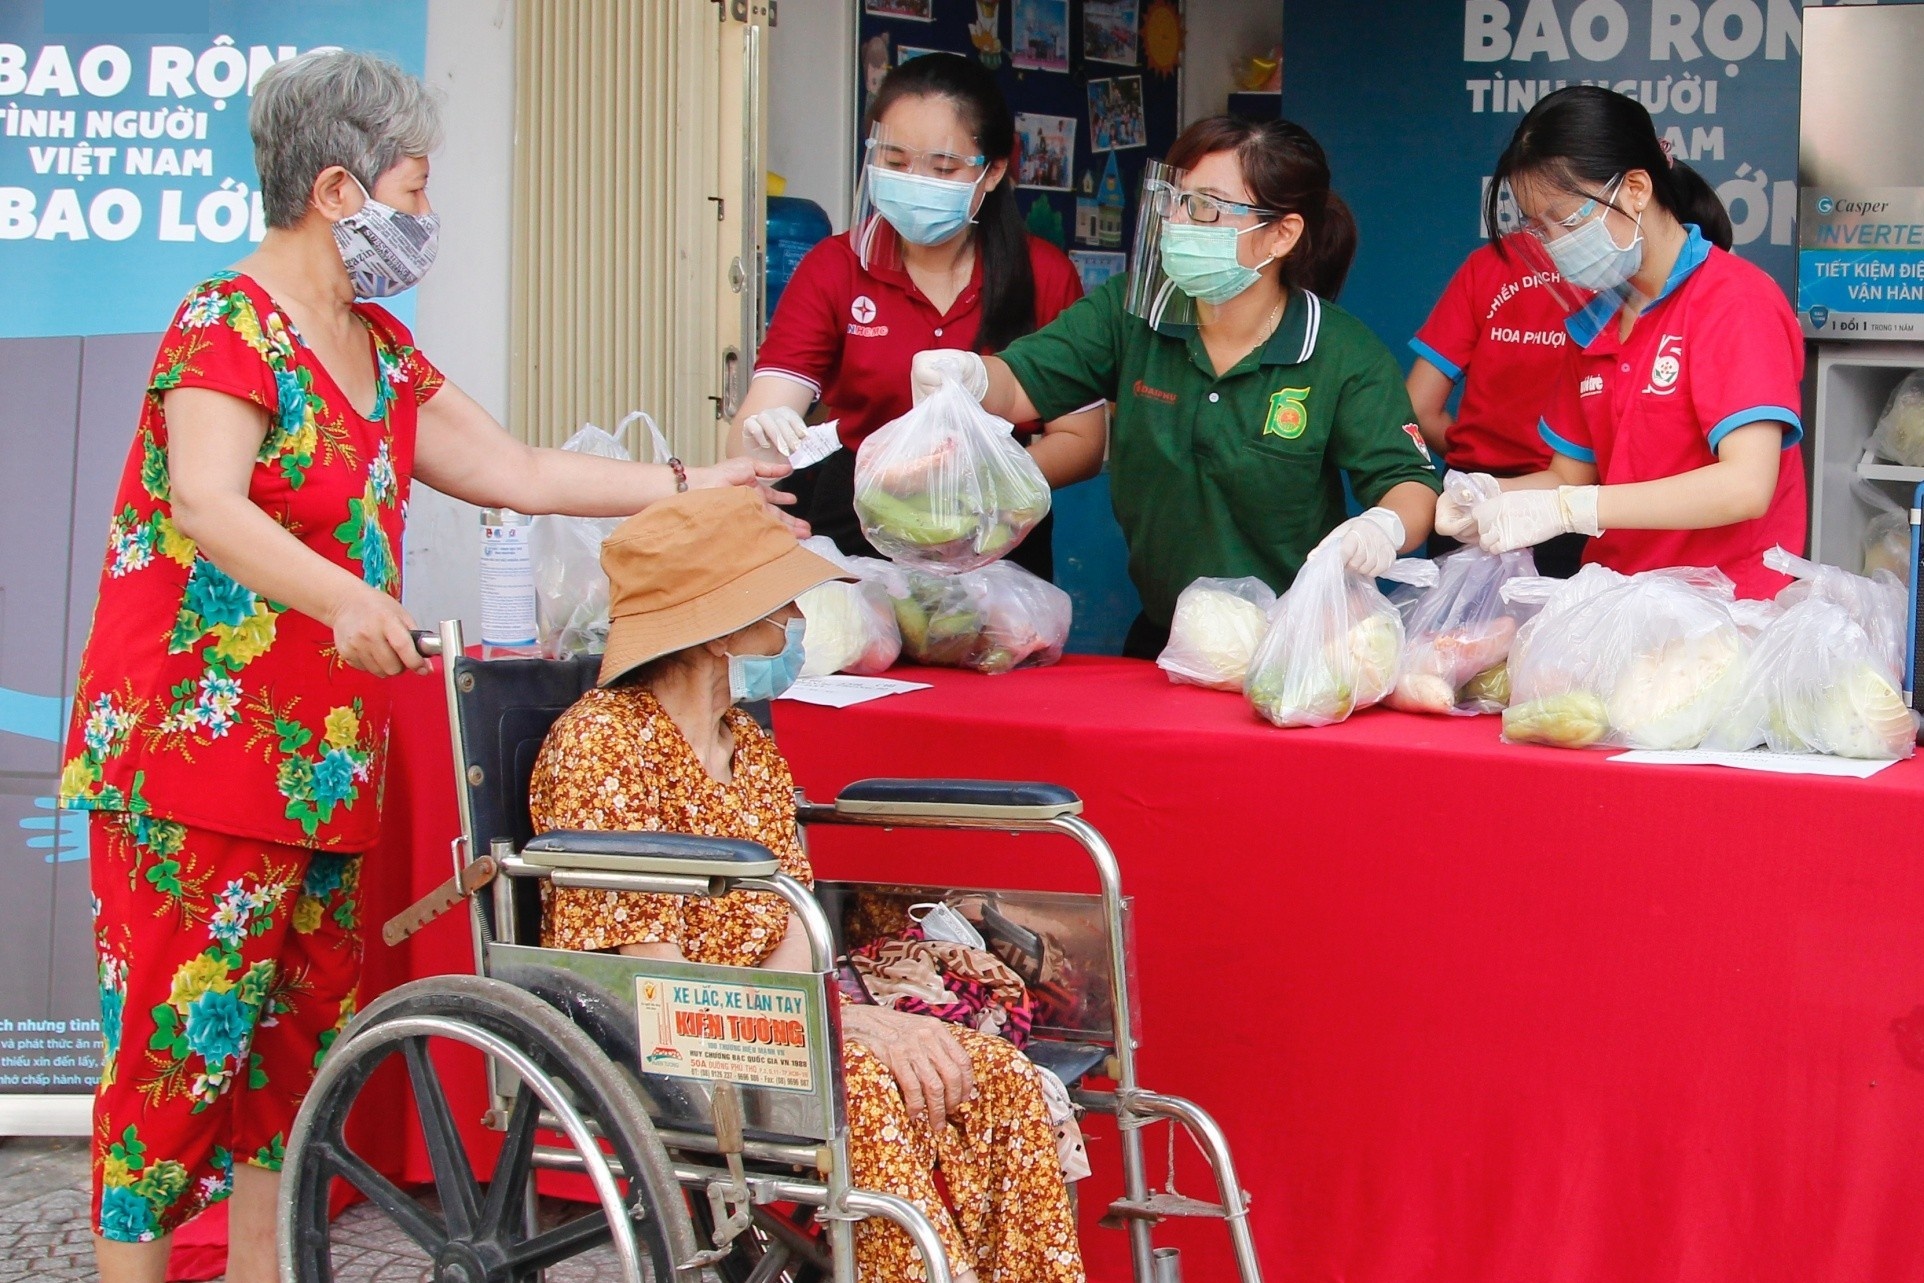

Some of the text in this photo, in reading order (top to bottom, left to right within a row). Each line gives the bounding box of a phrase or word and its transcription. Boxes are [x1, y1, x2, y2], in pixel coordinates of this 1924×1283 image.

[1464, 0, 1629, 62] BAO
[0, 43, 132, 98] BAO
[1466, 71, 1566, 112] TÌN
[0, 102, 208, 139] ÌNH NGƯỜI
[1658, 126, 1725, 160] AM
[29, 141, 213, 182] VIỆT NAM
[0, 186, 143, 242] BAO
[1835, 199, 1889, 216] Casper
[1521, 270, 1560, 288] DỊCH
[1815, 258, 1851, 277] TIẾT
[1855, 260, 1895, 281] KIỆM
[1848, 282, 1882, 303] VẬN
[1490, 327, 1520, 343] HOA
[673, 986, 689, 1004] XE
[725, 991, 742, 1009] XE
[746, 989, 772, 1011] LĂN
[776, 995, 802, 1014] TAY
